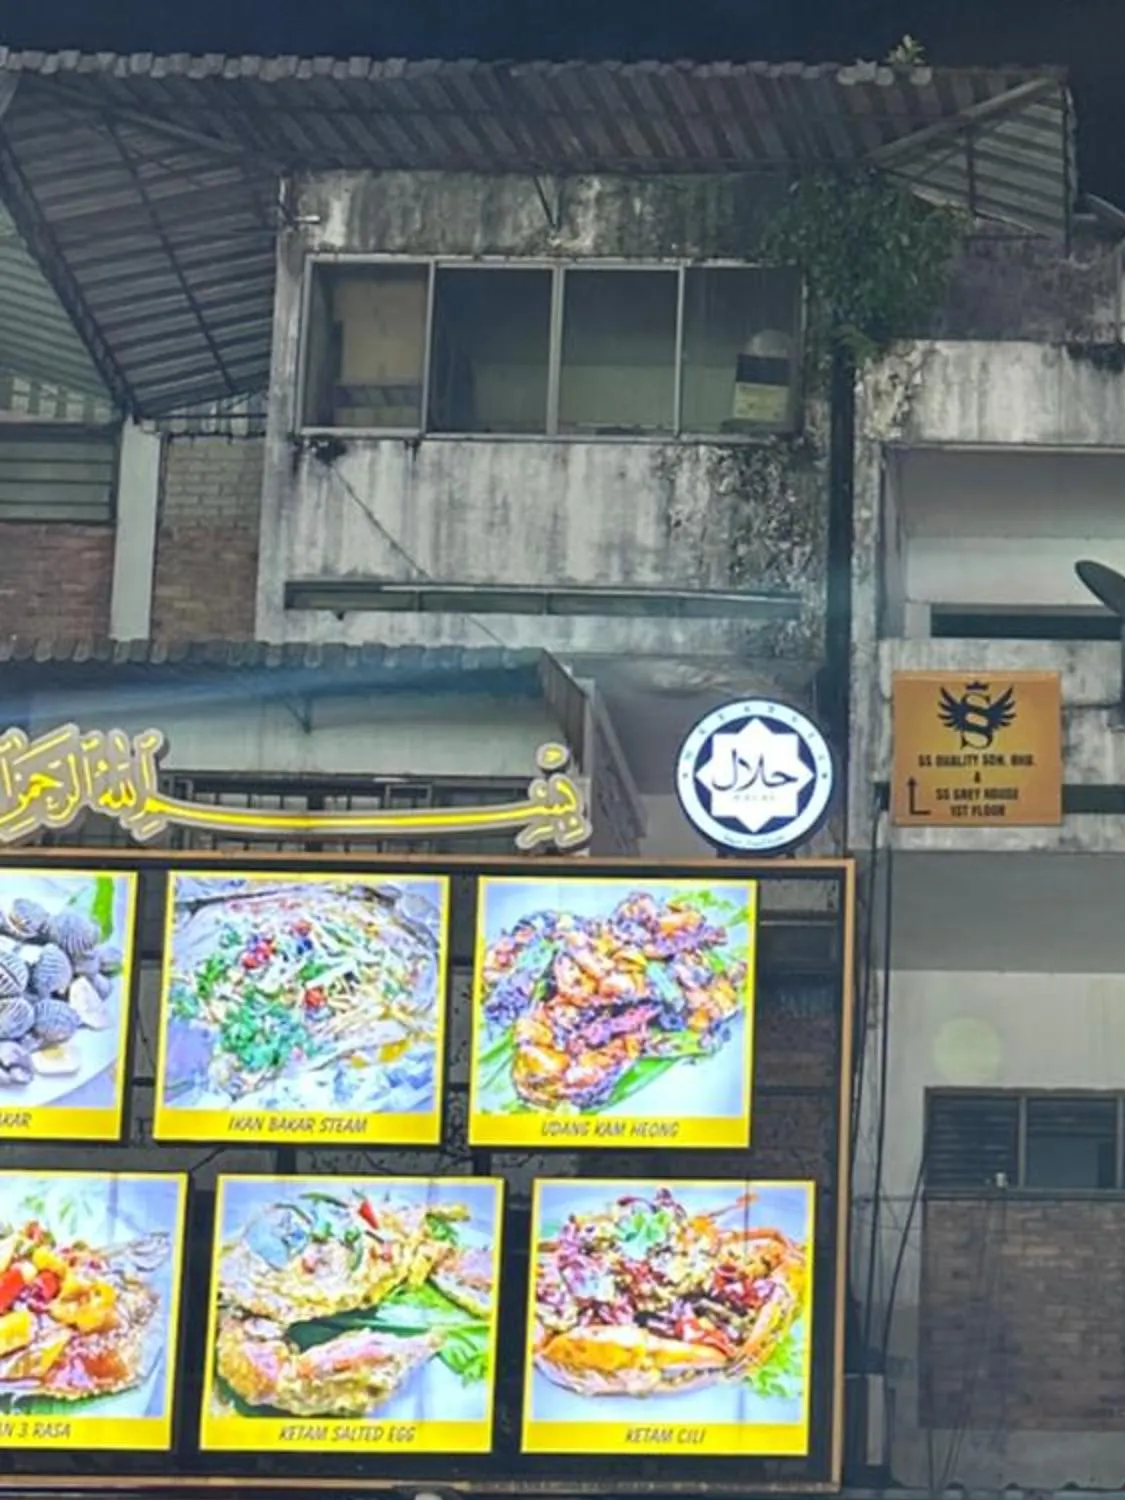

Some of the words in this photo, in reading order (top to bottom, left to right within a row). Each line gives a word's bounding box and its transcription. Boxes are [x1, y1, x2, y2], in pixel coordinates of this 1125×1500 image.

[711, 748, 798, 792] حلال
[0, 1113, 32, 1129] KAR
[228, 1117, 264, 1132] IKAN
[268, 1117, 314, 1132] BAKAR
[319, 1118, 367, 1133] STEAM
[541, 1121, 588, 1137] UDANG
[593, 1122, 626, 1137] KAM
[630, 1122, 681, 1138] HEONG
[18, 1422, 29, 1438] 3
[33, 1422, 72, 1438] RASA
[279, 1426, 327, 1441] KETAM
[332, 1426, 383, 1442] SALTED
[388, 1426, 416, 1442] EGG
[625, 1427, 673, 1443] KETAM
[677, 1428, 706, 1443] CILI
